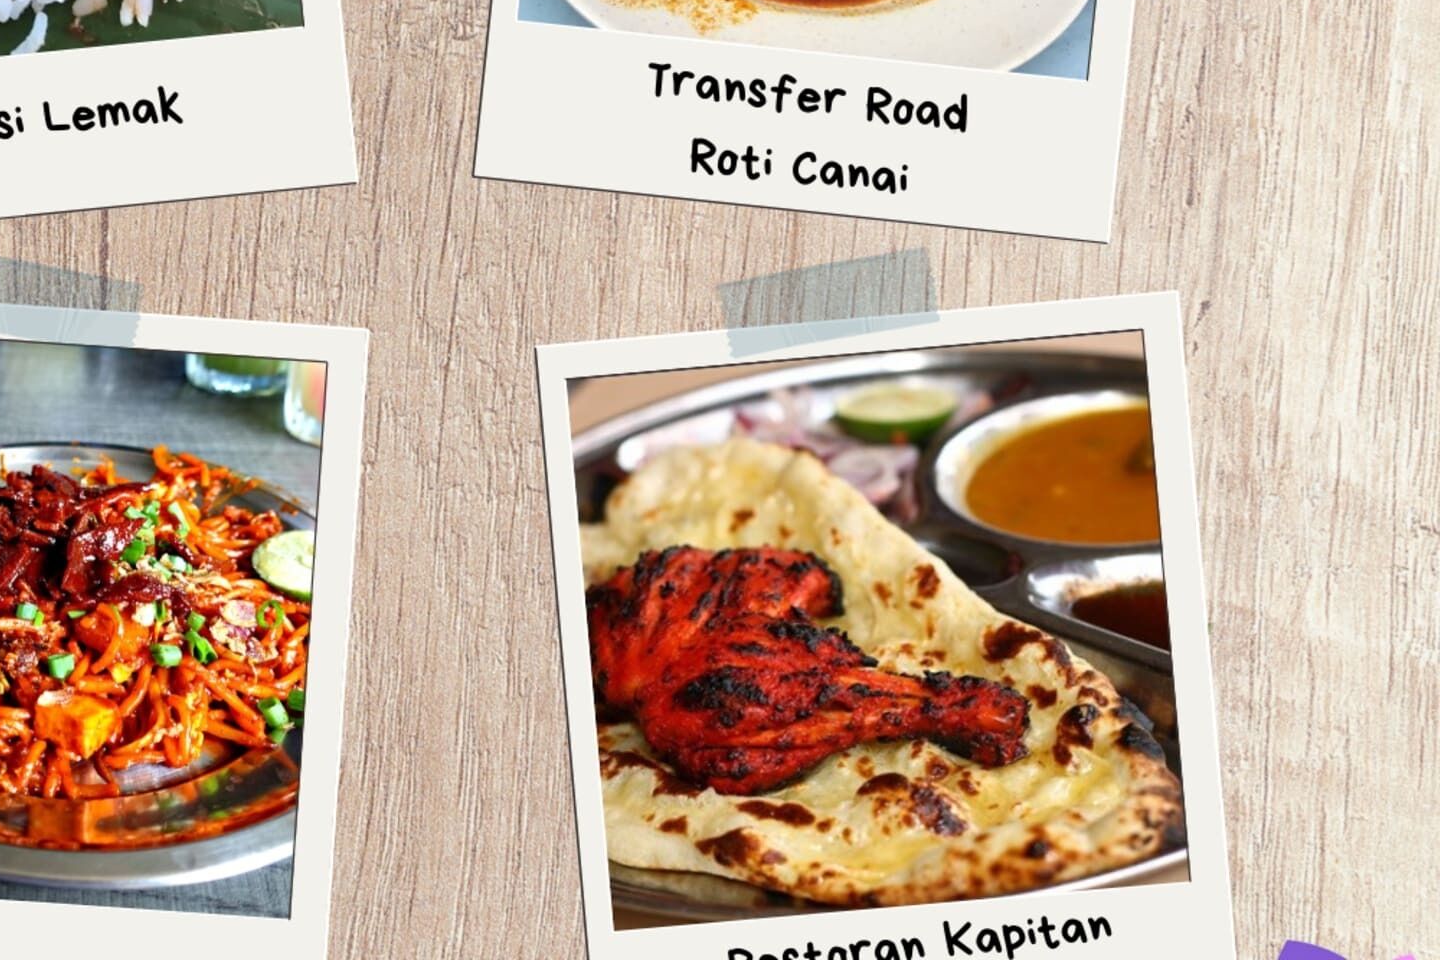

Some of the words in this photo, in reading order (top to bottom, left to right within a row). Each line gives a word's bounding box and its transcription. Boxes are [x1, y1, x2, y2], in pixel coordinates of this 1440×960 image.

[42, 85, 185, 132] Lemak
[648, 62, 847, 115] Transfer
[866, 86, 968, 133] Road
[690, 137, 773, 181] Roti
[792, 151, 909, 195] Canai
[727, 937, 926, 960] storan
[942, 915, 1112, 960] Kapitan
